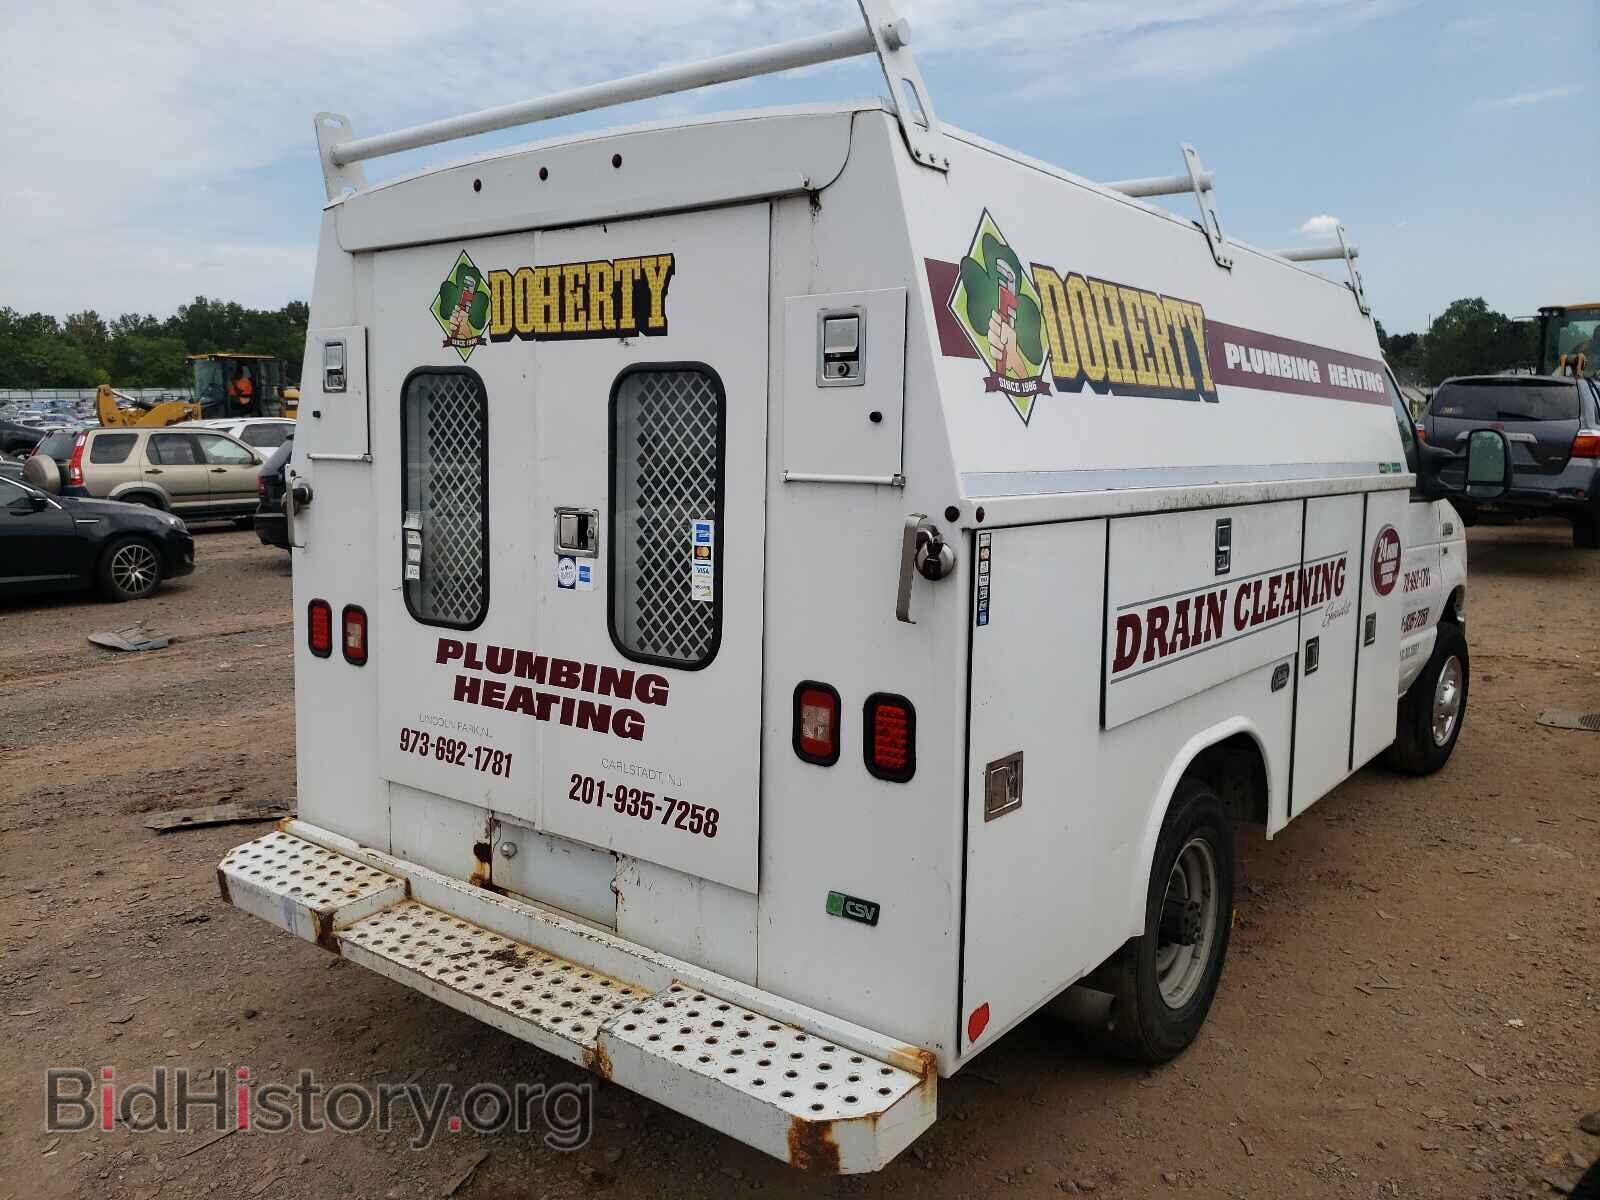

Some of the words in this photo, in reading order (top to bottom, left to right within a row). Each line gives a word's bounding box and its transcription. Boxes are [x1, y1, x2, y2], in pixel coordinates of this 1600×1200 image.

[488, 253, 675, 342] DOHERTY
[1030, 262, 1218, 402] DOHERTY
[998, 377, 1020, 393] SINCE
[1224, 342, 1321, 383] PLUMBING
[1328, 363, 1385, 393] HEATING
[1112, 589, 1227, 674] DRAIN
[1234, 557, 1347, 631] CLEANING
[435, 638, 670, 707] PLUMBING
[453, 675, 646, 742] HEATING
[399, 727, 513, 778] 973-692-1781
[568, 773, 720, 838] 201-935-7258
[845, 900, 876, 921] CSV
